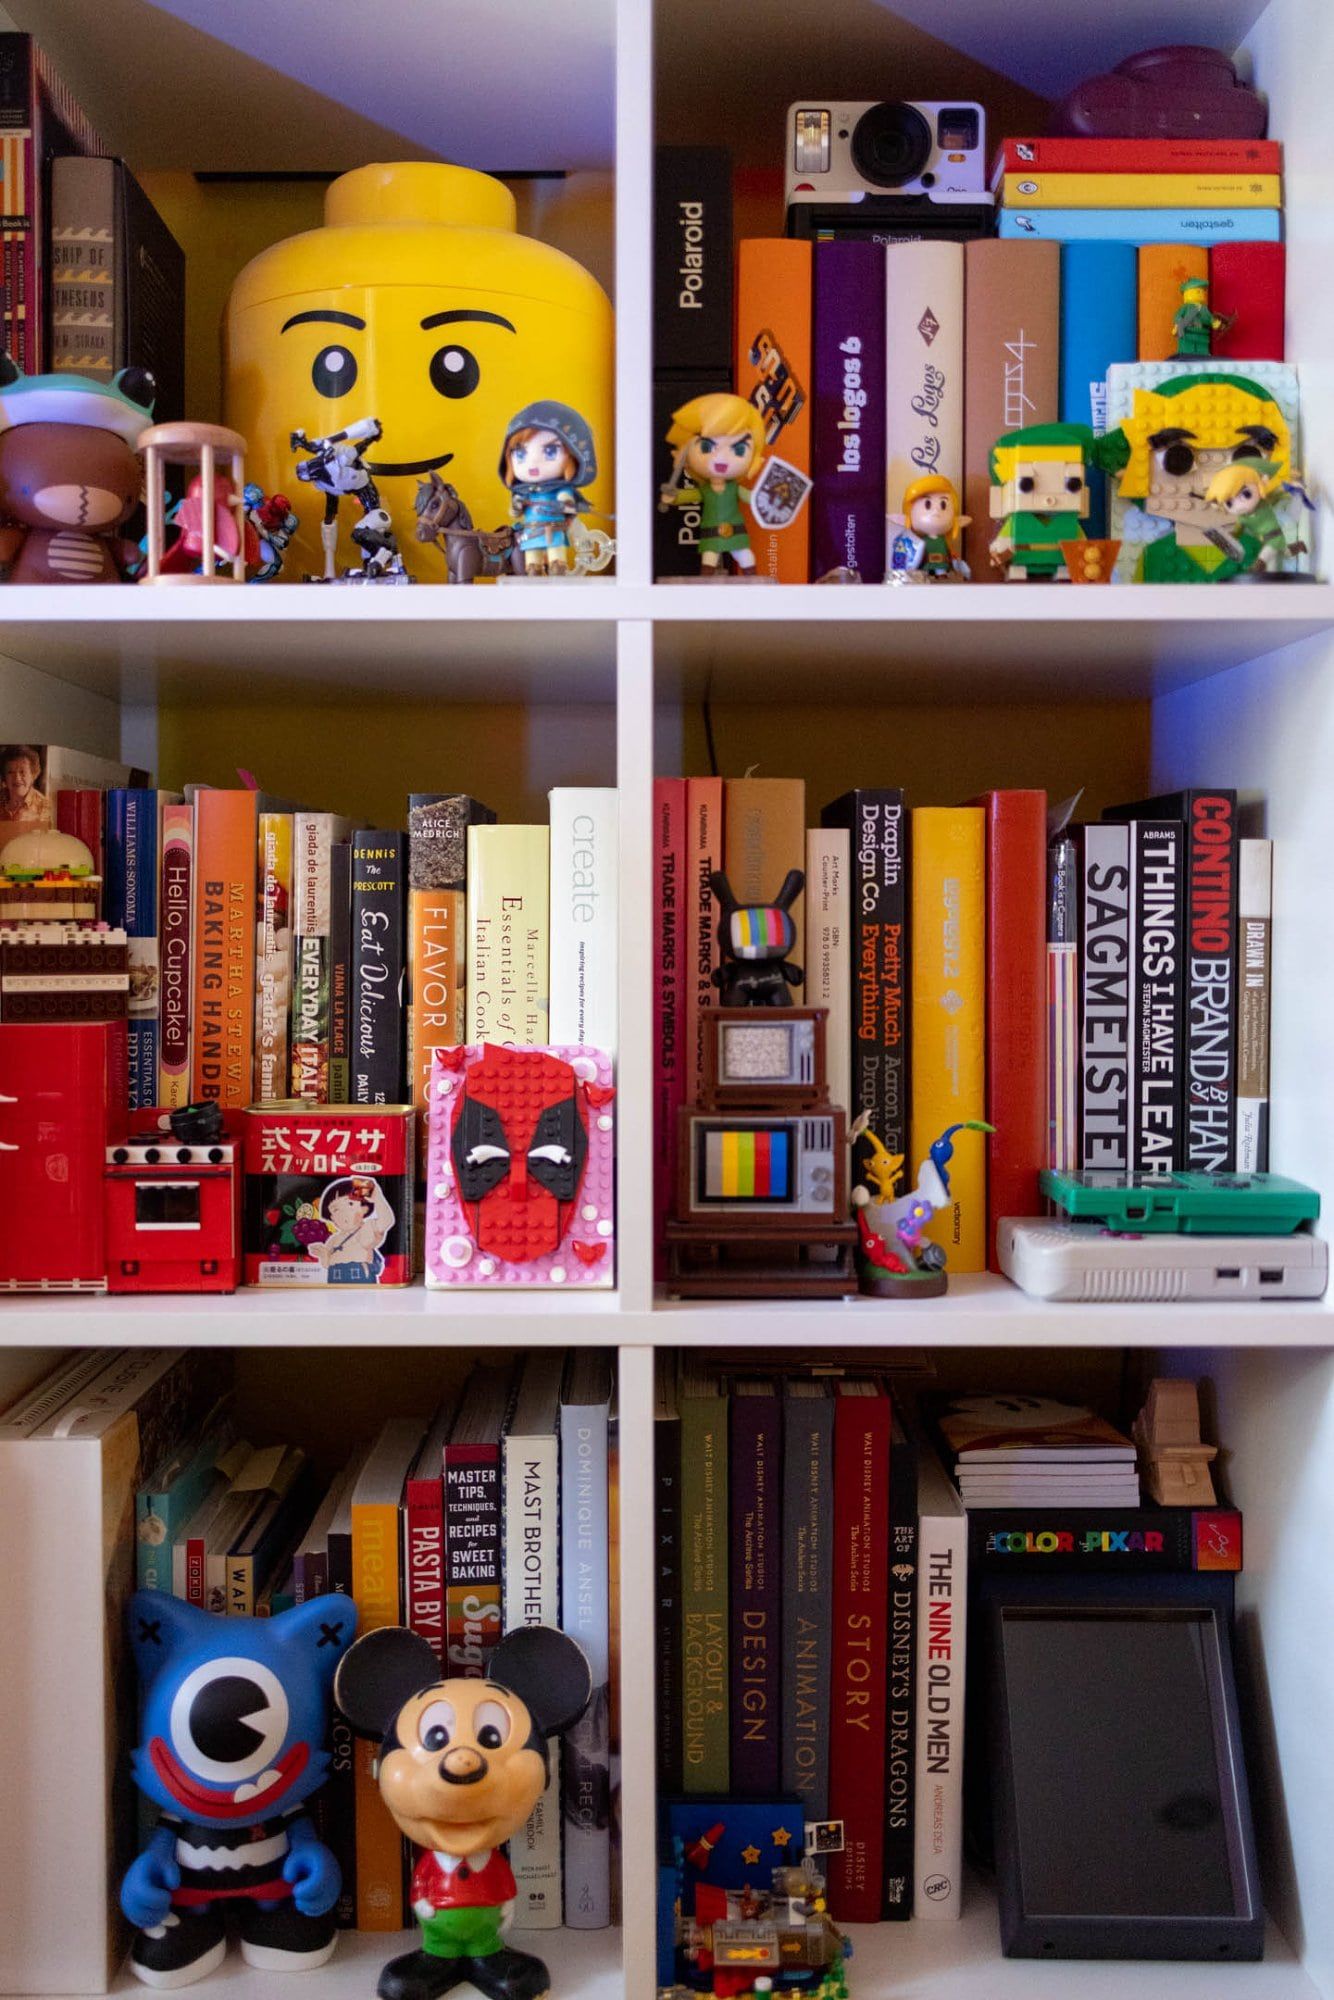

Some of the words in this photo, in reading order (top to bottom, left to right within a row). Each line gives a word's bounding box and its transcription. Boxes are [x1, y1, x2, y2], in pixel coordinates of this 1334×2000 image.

[54, 247, 83, 265] SHIP
[89, 248, 105, 265] OF
[680, 202, 703, 309] Polaroid
[55, 290, 105, 308] THESEUS
[838, 336, 861, 354] 6
[837, 358, 867, 430] logos
[910, 363, 945, 427] Logos
[837, 434, 860, 472] los
[910, 436, 940, 474] Los
[844, 514, 858, 568] gestalten
[305, 824, 319, 856] giada
[413, 829, 460, 839] MEDRICH
[421, 819, 451, 829] ALICE
[859, 804, 879, 880] Design
[883, 804, 901, 886] Draplin
[1143, 831, 1176, 839] ABRAMS
[125, 801, 137, 923] WILLIAMS-SONOMA
[265, 832, 278, 870] giada
[307, 859, 319, 873] de
[366, 865, 382, 875] The
[572, 815, 600, 923] create
[832, 855, 840, 868] Art
[1192, 797, 1232, 952] CONTINO
[165, 866, 187, 931] Hello,
[266, 874, 277, 892] de
[307, 876, 319, 933] laurentiis
[353, 881, 396, 892] PRESCOTT
[662, 852, 675, 908] TRADE
[698, 857, 712, 911] TRADE
[822, 855, 830, 911] Counter-Print
[832, 871, 840, 896] Marks
[862, 883, 879, 915] Co.
[1057, 870, 1066, 891] Book
[203, 881, 224, 990] BAKING
[265, 895, 277, 962] laurentiis
[361, 907, 390, 956] Eat
[822, 926, 830, 942] 978
[1142, 842, 1175, 977] THINGS
[229, 881, 245, 1000] MARTHA
[422, 907, 449, 1027] FLAVOR
[476, 919, 492, 982] Italian
[501, 896, 523, 1005] Essentials
[526, 929, 539, 1003] Marcella
[662, 912, 675, 970] MARKS
[698, 915, 712, 973] MARKS
[881, 923, 902, 983] Pretty
[1245, 922, 1265, 968] DRAWN
[164, 937, 187, 1047] Cupcake!
[300, 937, 320, 1042] EVERYDAY
[334, 963, 344, 996] VIANA
[578, 972, 586, 997] recipes
[662, 975, 675, 986] &
[698, 979, 711, 990] &
[858, 924, 879, 1040] Everything
[1142, 984, 1151, 1015] STEFAN
[1151, 983, 1174, 996] I
[1245, 974, 1265, 988] IN
[260, 973, 276, 1047] giada's
[334, 1002, 344, 1014] LA
[360, 963, 390, 1060] Delicious
[497, 1013, 517, 1036] of
[662, 990, 675, 1067] SYMBOLS
[883, 987, 901, 1046] Much
[1190, 958, 1230, 1083] BRAND
[202, 1001, 222, 1098] HANDB
[227, 1008, 243, 1109] STEWA
[334, 1019, 344, 1053] PLACE
[578, 1029, 586, 1043] day
[1142, 1018, 1151, 1073] SAGMEISTER
[1151, 1004, 1174, 1073] HAVE
[143, 1031, 153, 1095] ESSENTIALS
[300, 1047, 319, 1098] ITALI
[884, 1054, 901, 1120] Aaron
[1190, 1104, 1228, 1171] HAN
[862, 1432, 872, 1455] WALT
[448, 1469, 496, 1484] MASTER
[524, 1460, 541, 1522] MAST
[577, 1427, 593, 1549] DOMINIQUE
[862, 1459, 872, 1493] DISNEY
[449, 1524, 497, 1538] RECIPES
[467, 1540, 478, 1549] for
[850, 1525, 860, 1541] The
[862, 1496, 872, 1549] ANIMATION
[994, 1530, 1074, 1553] COLOR
[1086, 1530, 1164, 1553] PIXAR
[412, 1526, 441, 1594] PASTA
[452, 1550, 494, 1563] SWEET
[452, 1565, 495, 1579] BAKING
[524, 1527, 541, 1625] BROTHER
[850, 1541, 860, 1569] Archive
[850, 1570, 860, 1592] Series
[862, 1553, 872, 1592] STUDIOS
[929, 1549, 952, 1597] THE
[233, 1568, 246, 1612] WAF
[414, 1603, 442, 1629] BY
[577, 1562, 593, 1629] ANSEL
[705, 1612, 723, 1692] LAYOUT
[891, 1590, 912, 1697] DISNEY'S
[928, 1601, 952, 1661] NINE
[686, 1612, 704, 1764] BACKGROUND
[742, 1610, 767, 1742] DESIGN
[845, 1613, 871, 1732] STORY
[927, 1666, 951, 1714] OLD
[706, 1700, 723, 1714] &
[795, 1616, 818, 1791] ANIMATION
[889, 1710, 910, 1829] DRAGONS
[927, 1720, 950, 1774] MEN
[933, 1785, 944, 1831] ANDREAS
[855, 1841, 865, 1891] DISNEY
[933, 1832, 943, 1855] DEJA
